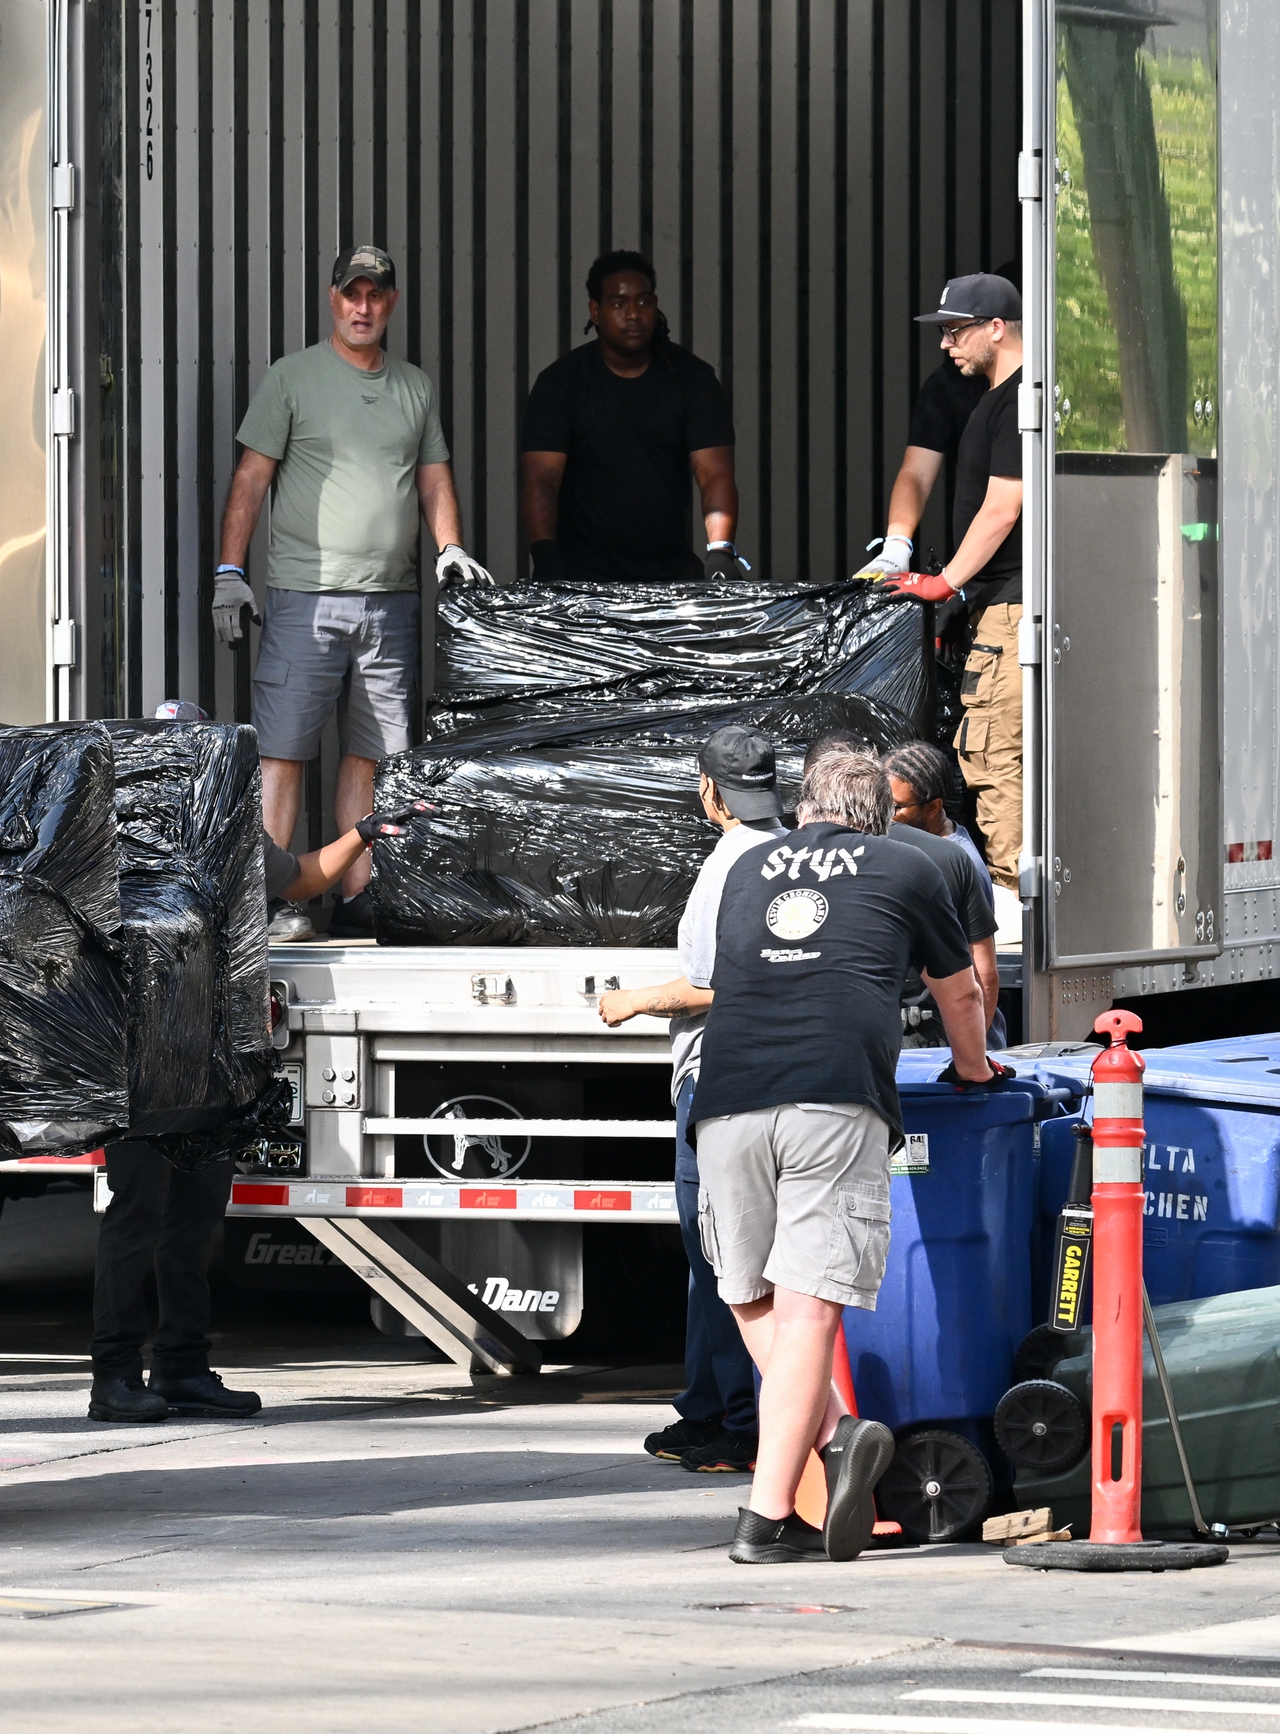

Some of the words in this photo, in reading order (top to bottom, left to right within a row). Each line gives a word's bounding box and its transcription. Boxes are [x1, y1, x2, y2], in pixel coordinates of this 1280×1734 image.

[144, 0, 154, 181] 7326
[1143, 1144, 1195, 1173] LTA
[244, 1234, 325, 1265] Great
[481, 1277, 560, 1312] Dane
[1058, 1245, 1082, 1324] GARRETT
